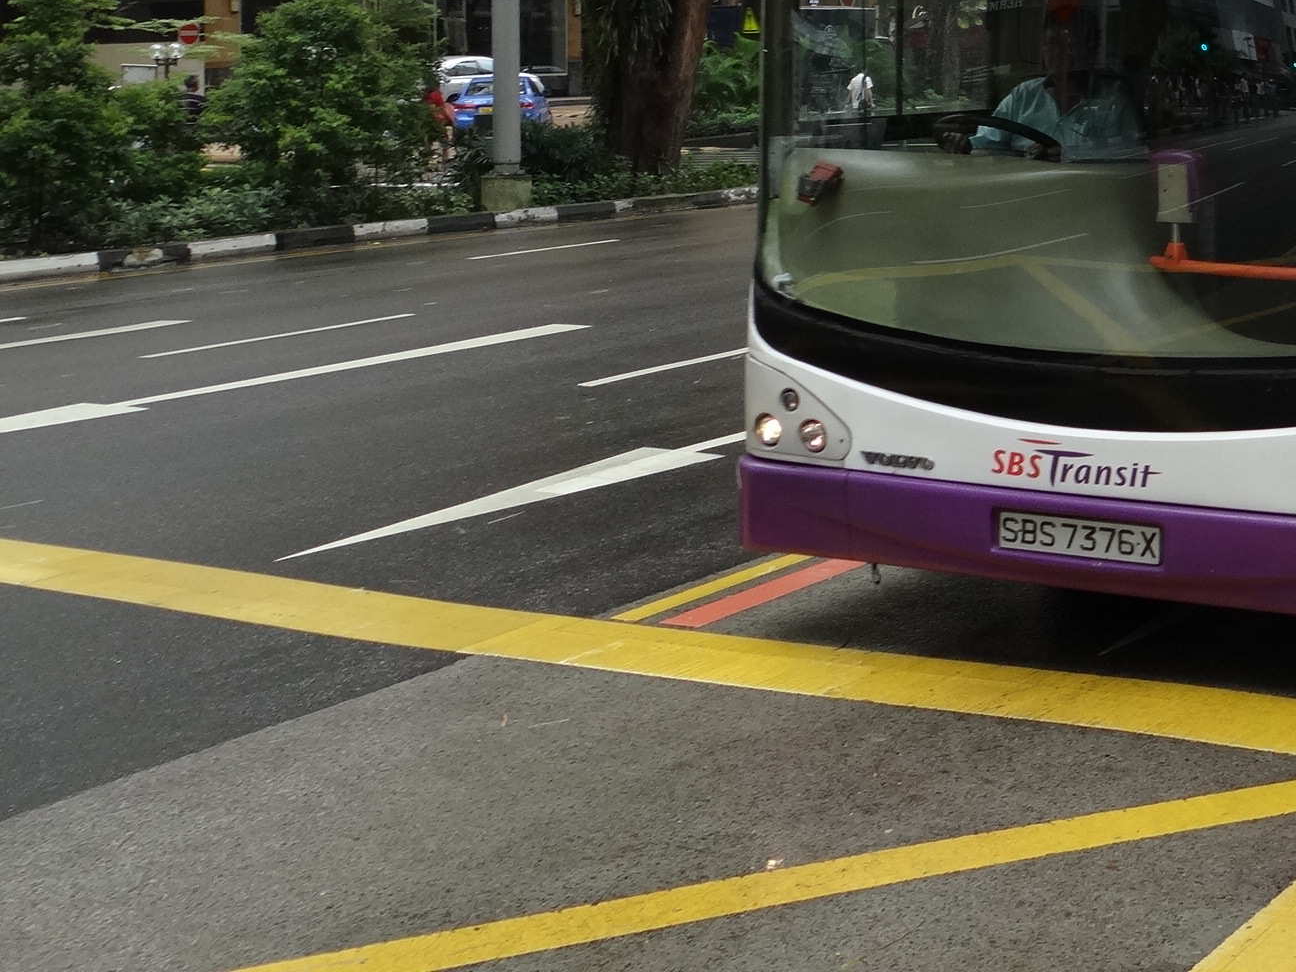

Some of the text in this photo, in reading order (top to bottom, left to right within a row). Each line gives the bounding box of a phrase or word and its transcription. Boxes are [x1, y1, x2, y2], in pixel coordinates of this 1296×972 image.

[991, 449, 1163, 488] SBS Transit
[1002, 516, 1159, 560] SBS7376X
